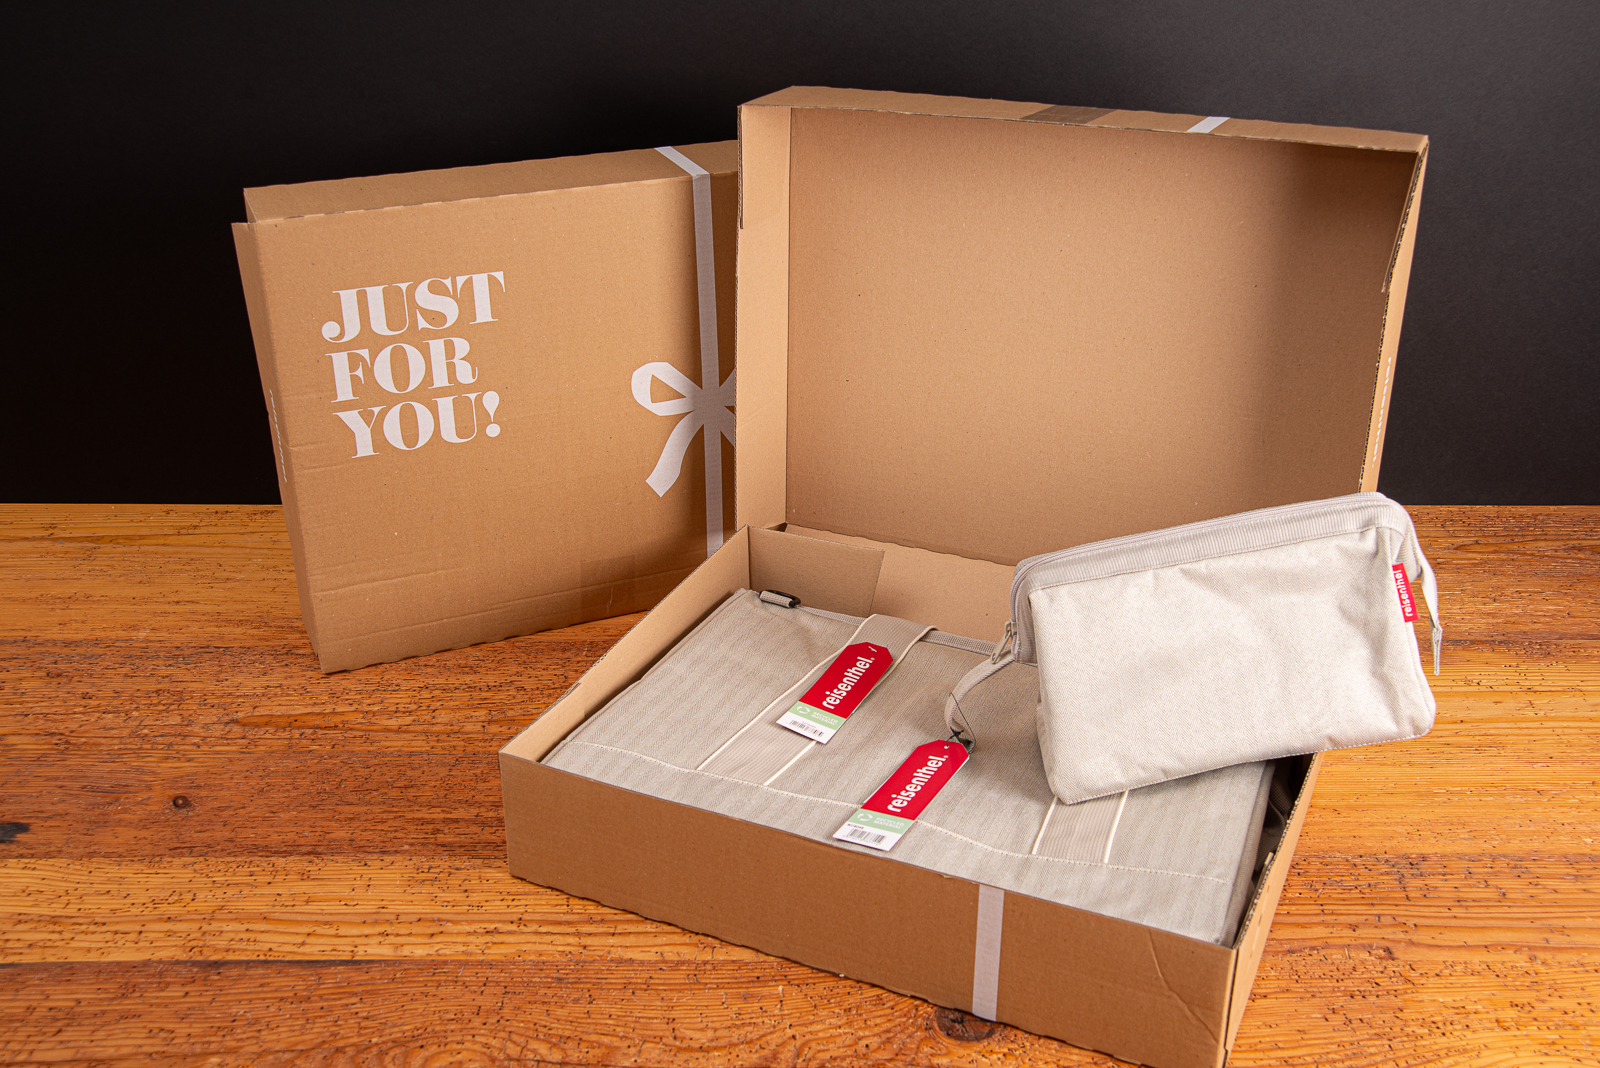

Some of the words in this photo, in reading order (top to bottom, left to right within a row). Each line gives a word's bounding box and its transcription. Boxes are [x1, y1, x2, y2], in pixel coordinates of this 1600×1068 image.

[321, 270, 506, 343] JUST
[324, 337, 478, 403] FOR
[332, 390, 501, 459] YOU!
[1393, 569, 1414, 617] reisenthel
